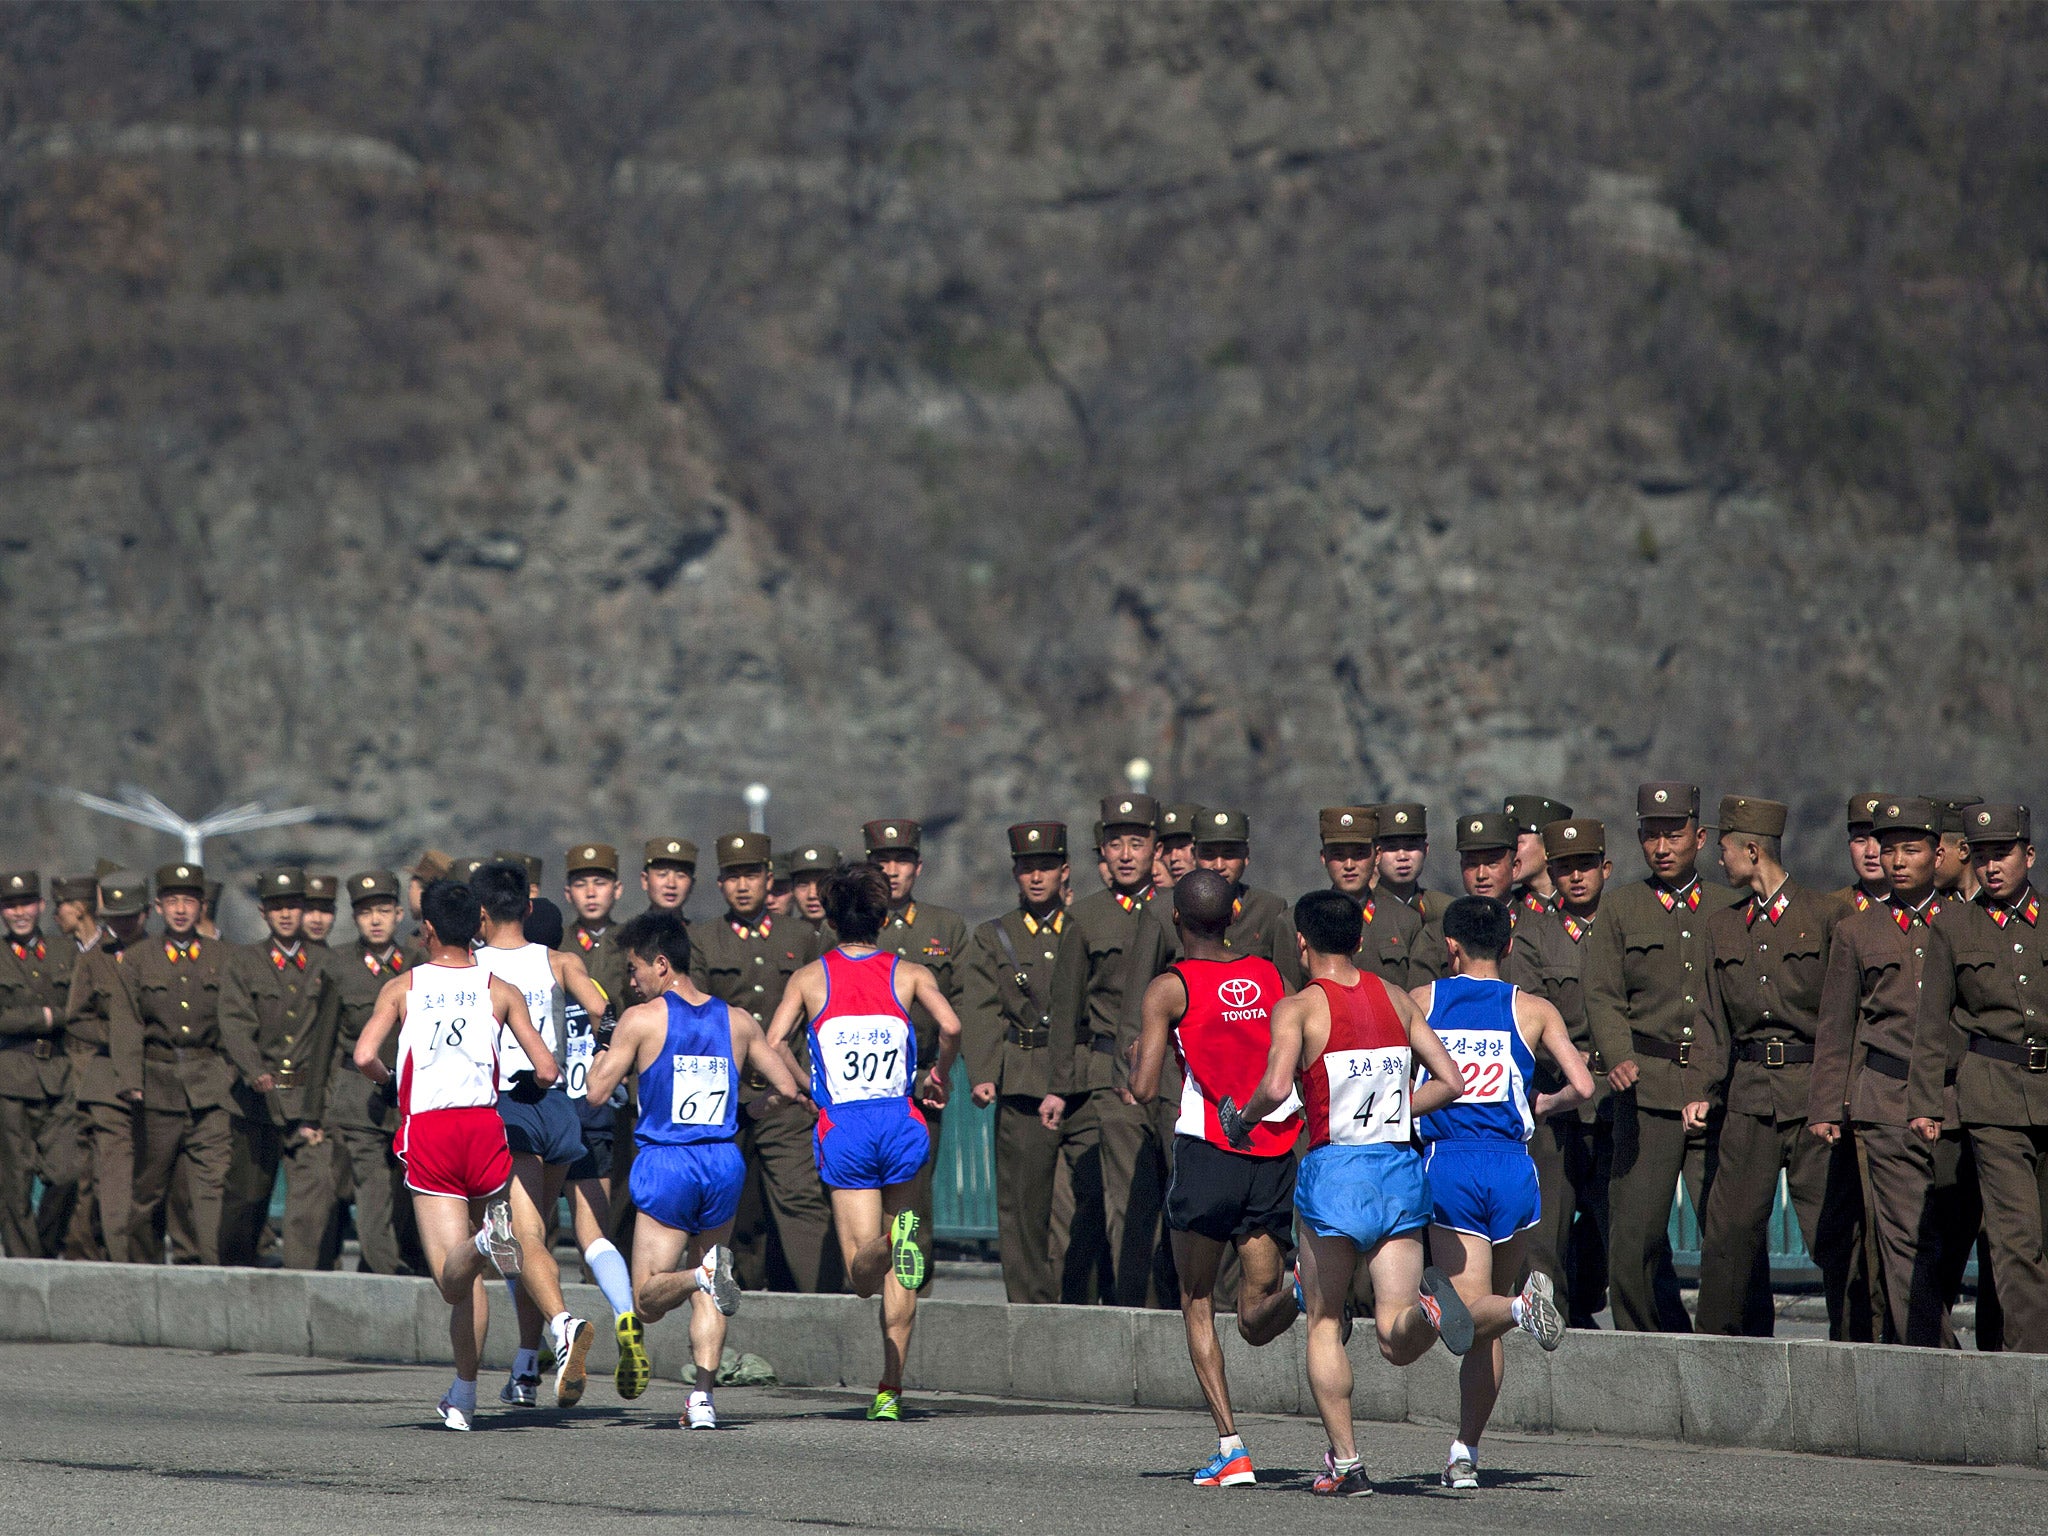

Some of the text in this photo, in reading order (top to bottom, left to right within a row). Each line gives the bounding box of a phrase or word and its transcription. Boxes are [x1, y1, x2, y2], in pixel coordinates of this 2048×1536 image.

[1221, 1008, 1267, 1022] TOYOTA
[429, 1017, 467, 1050] 18
[842, 1048, 899, 1082] 307
[678, 1090, 727, 1122] 67
[1352, 1089, 1403, 1128] 42
